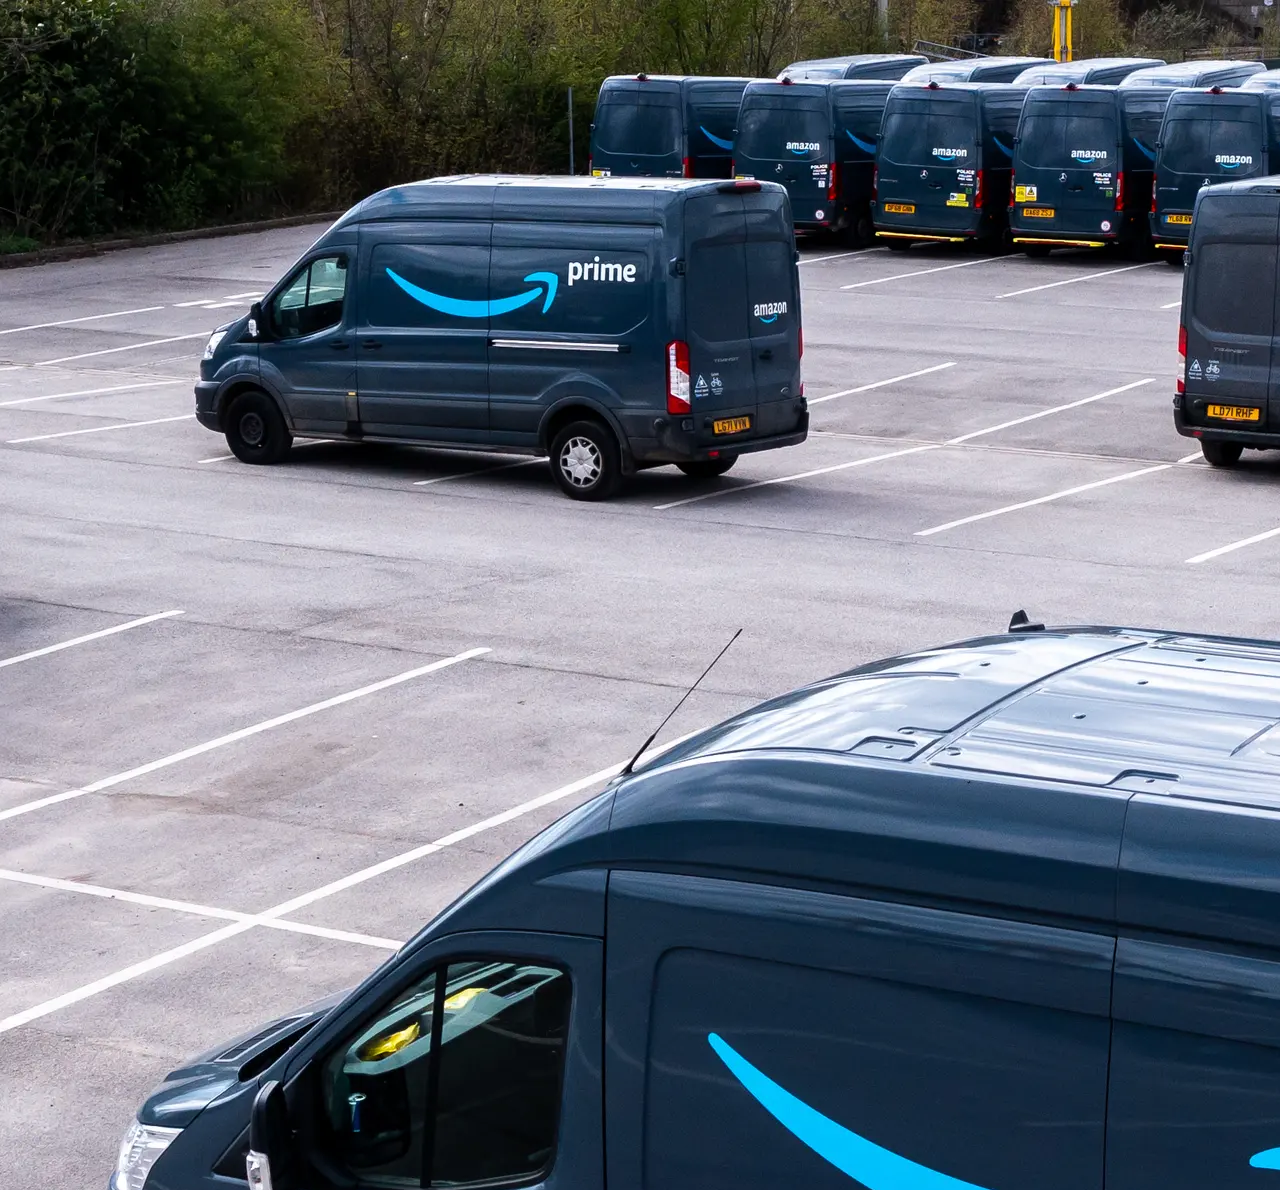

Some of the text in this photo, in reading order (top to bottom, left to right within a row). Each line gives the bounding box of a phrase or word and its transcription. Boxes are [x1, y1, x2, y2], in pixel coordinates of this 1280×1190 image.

[786, 141, 820, 151] amazon
[932, 147, 967, 157] amazon
[1071, 149, 1107, 159] amazon
[1215, 154, 1252, 164] amazon
[567, 255, 637, 287] prime
[753, 301, 788, 316] amazon
[1213, 406, 1254, 418] LD71 RHF
